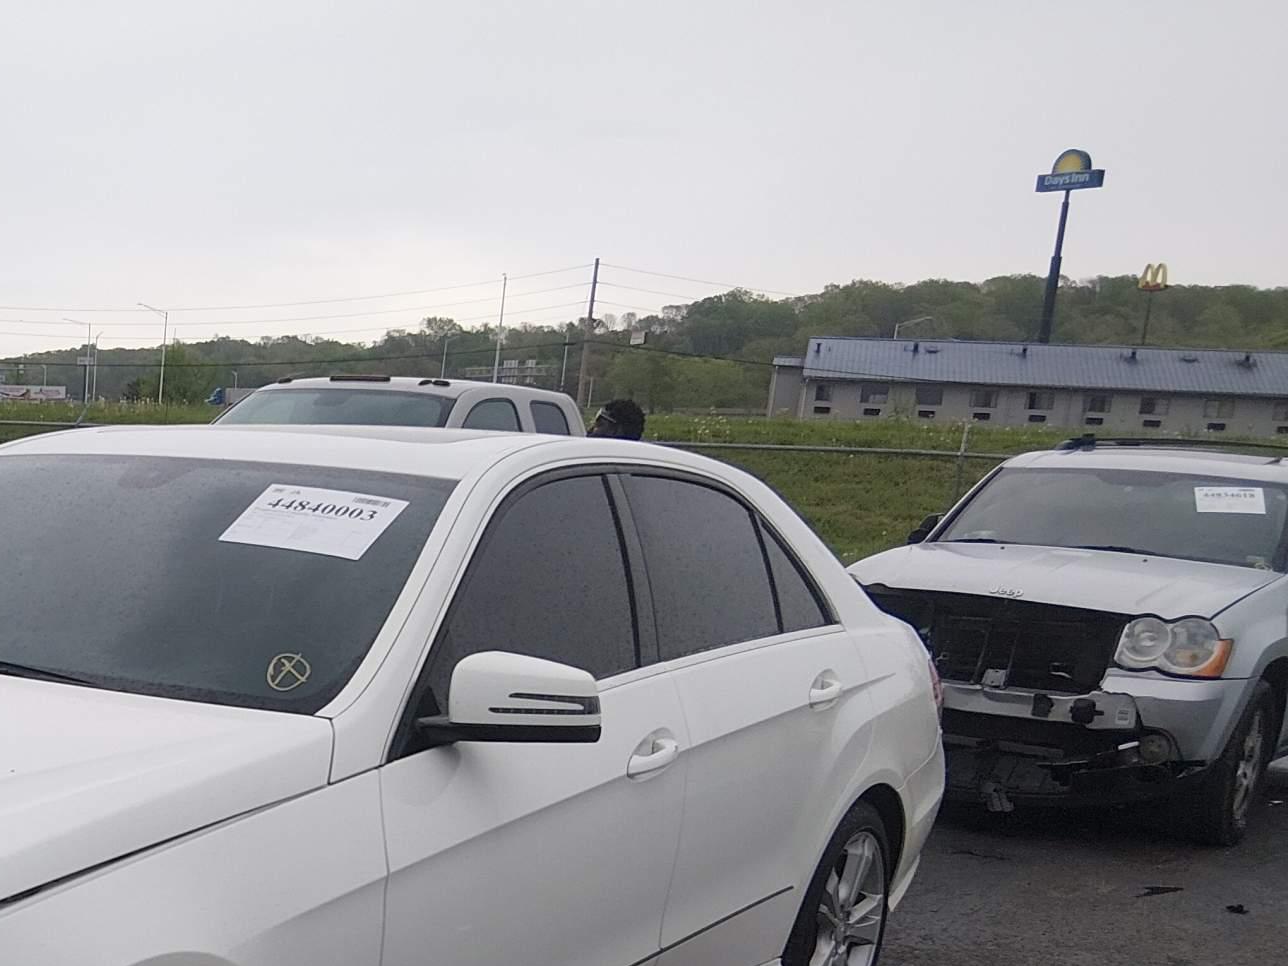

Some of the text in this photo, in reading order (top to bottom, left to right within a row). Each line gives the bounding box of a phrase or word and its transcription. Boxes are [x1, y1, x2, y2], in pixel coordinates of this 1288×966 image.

[1044, 173, 1090, 185] Days Inn
[267, 497, 378, 521] 44840003
[989, 584, 1024, 598] Jeep
